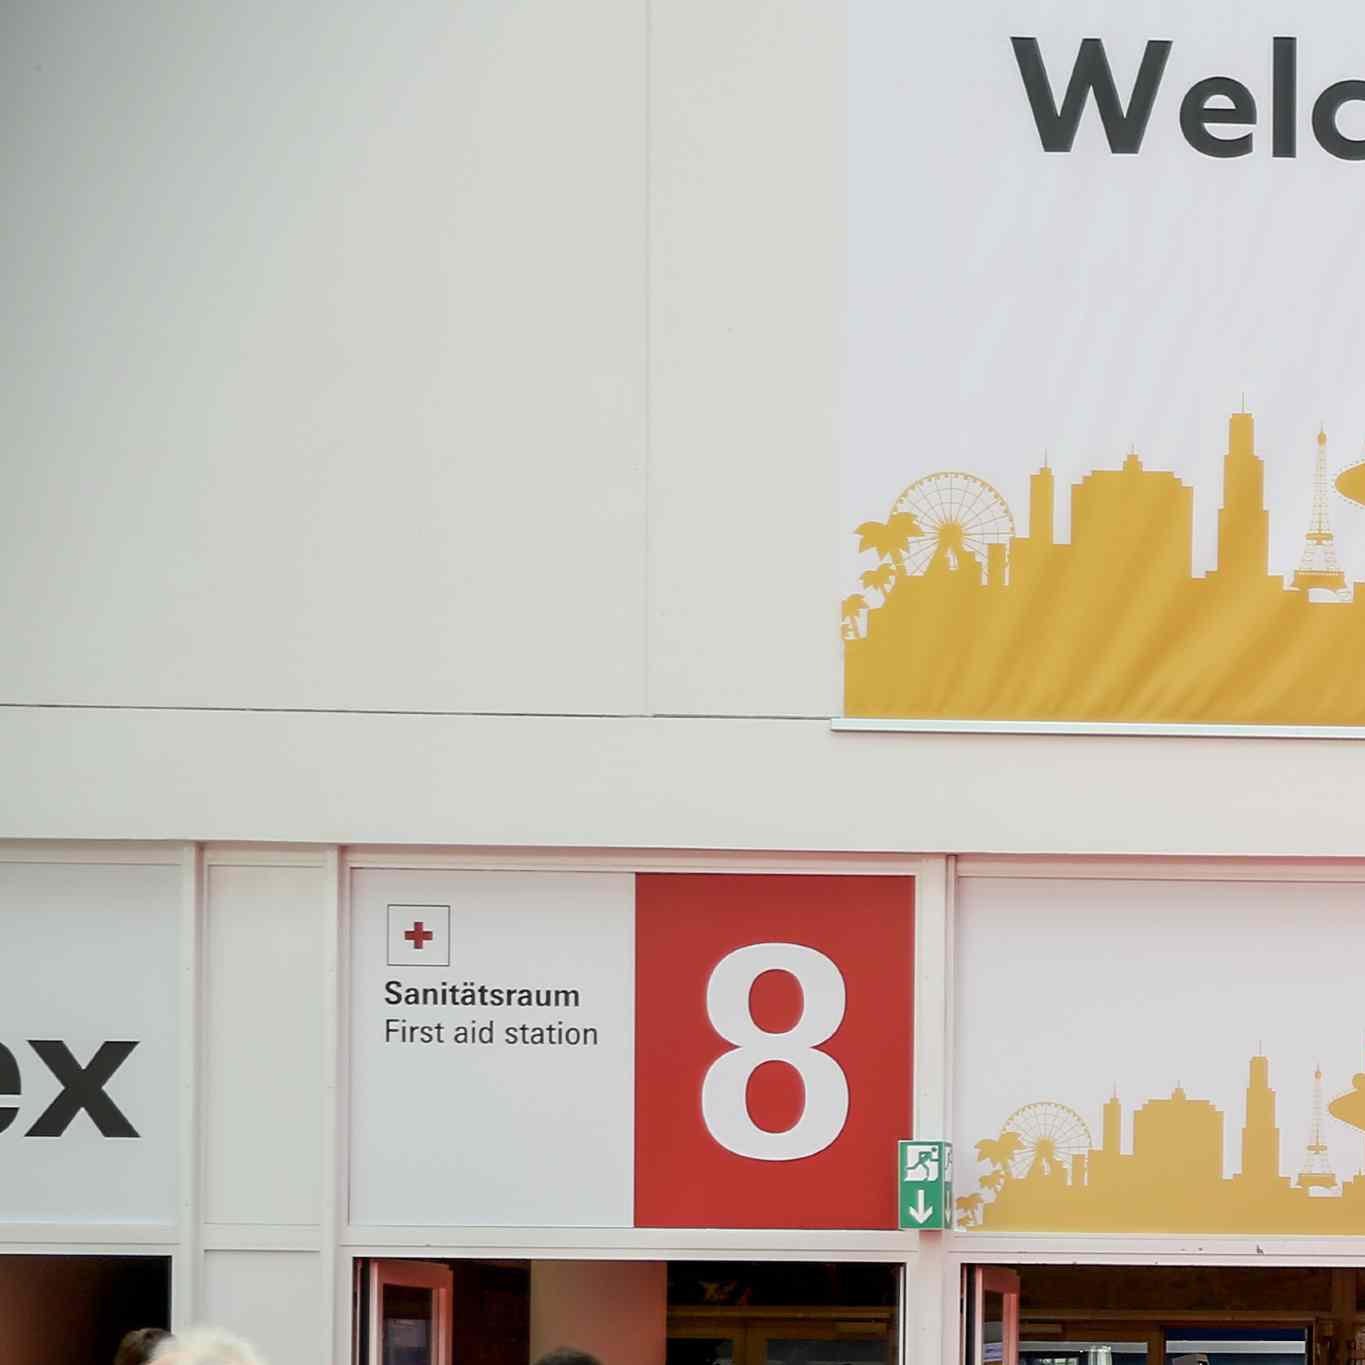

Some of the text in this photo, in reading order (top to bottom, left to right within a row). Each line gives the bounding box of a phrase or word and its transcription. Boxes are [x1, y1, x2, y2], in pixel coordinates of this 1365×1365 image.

[384, 980, 580, 1008] Sanitätsraum
[385, 1018, 599, 1046] First aid station
[700, 941, 850, 1162] 8
